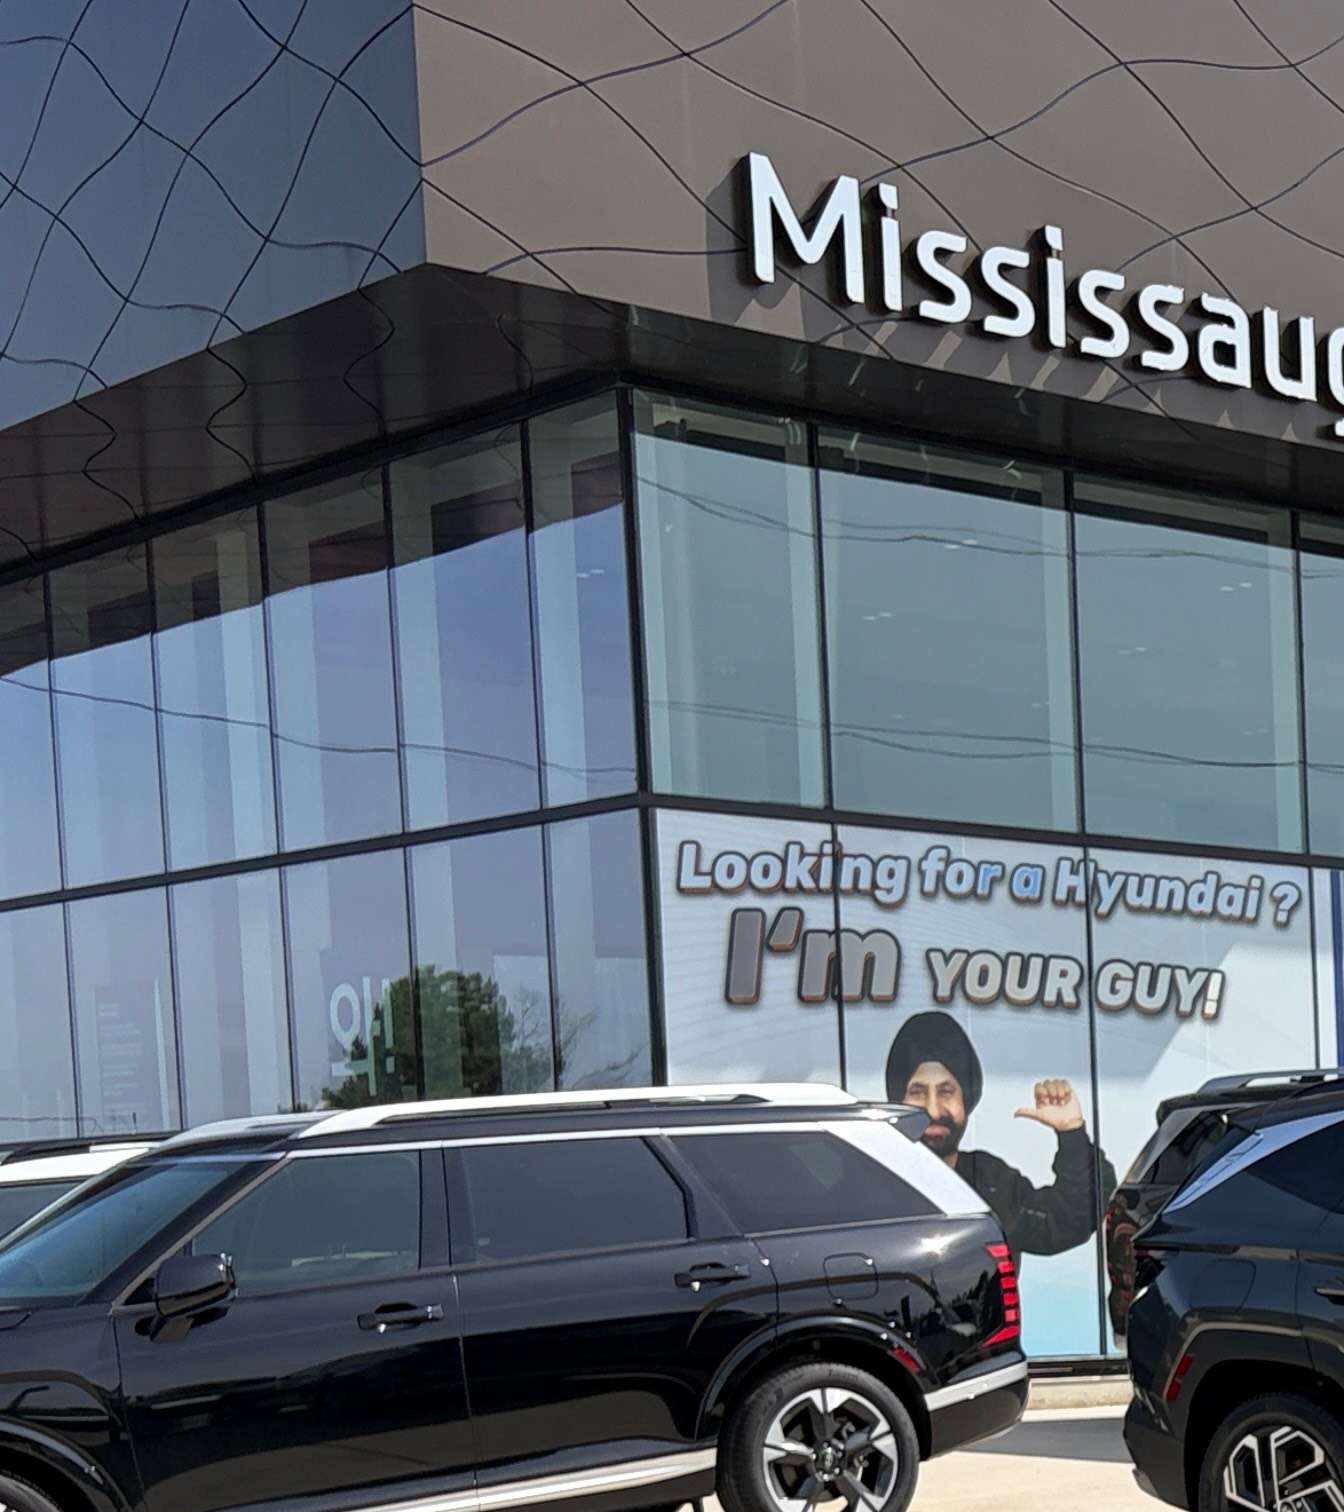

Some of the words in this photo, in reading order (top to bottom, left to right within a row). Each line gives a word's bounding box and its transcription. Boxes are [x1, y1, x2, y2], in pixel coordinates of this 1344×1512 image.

[677, 840, 908, 902] Looking
[920, 846, 1003, 900] for
[1010, 862, 1047, 901] a
[1053, 858, 1264, 922] Hyundai
[725, 907, 901, 1004] I'm
[926, 948, 1083, 1009] YOUR
[1094, 960, 1226, 1019] GUY!
